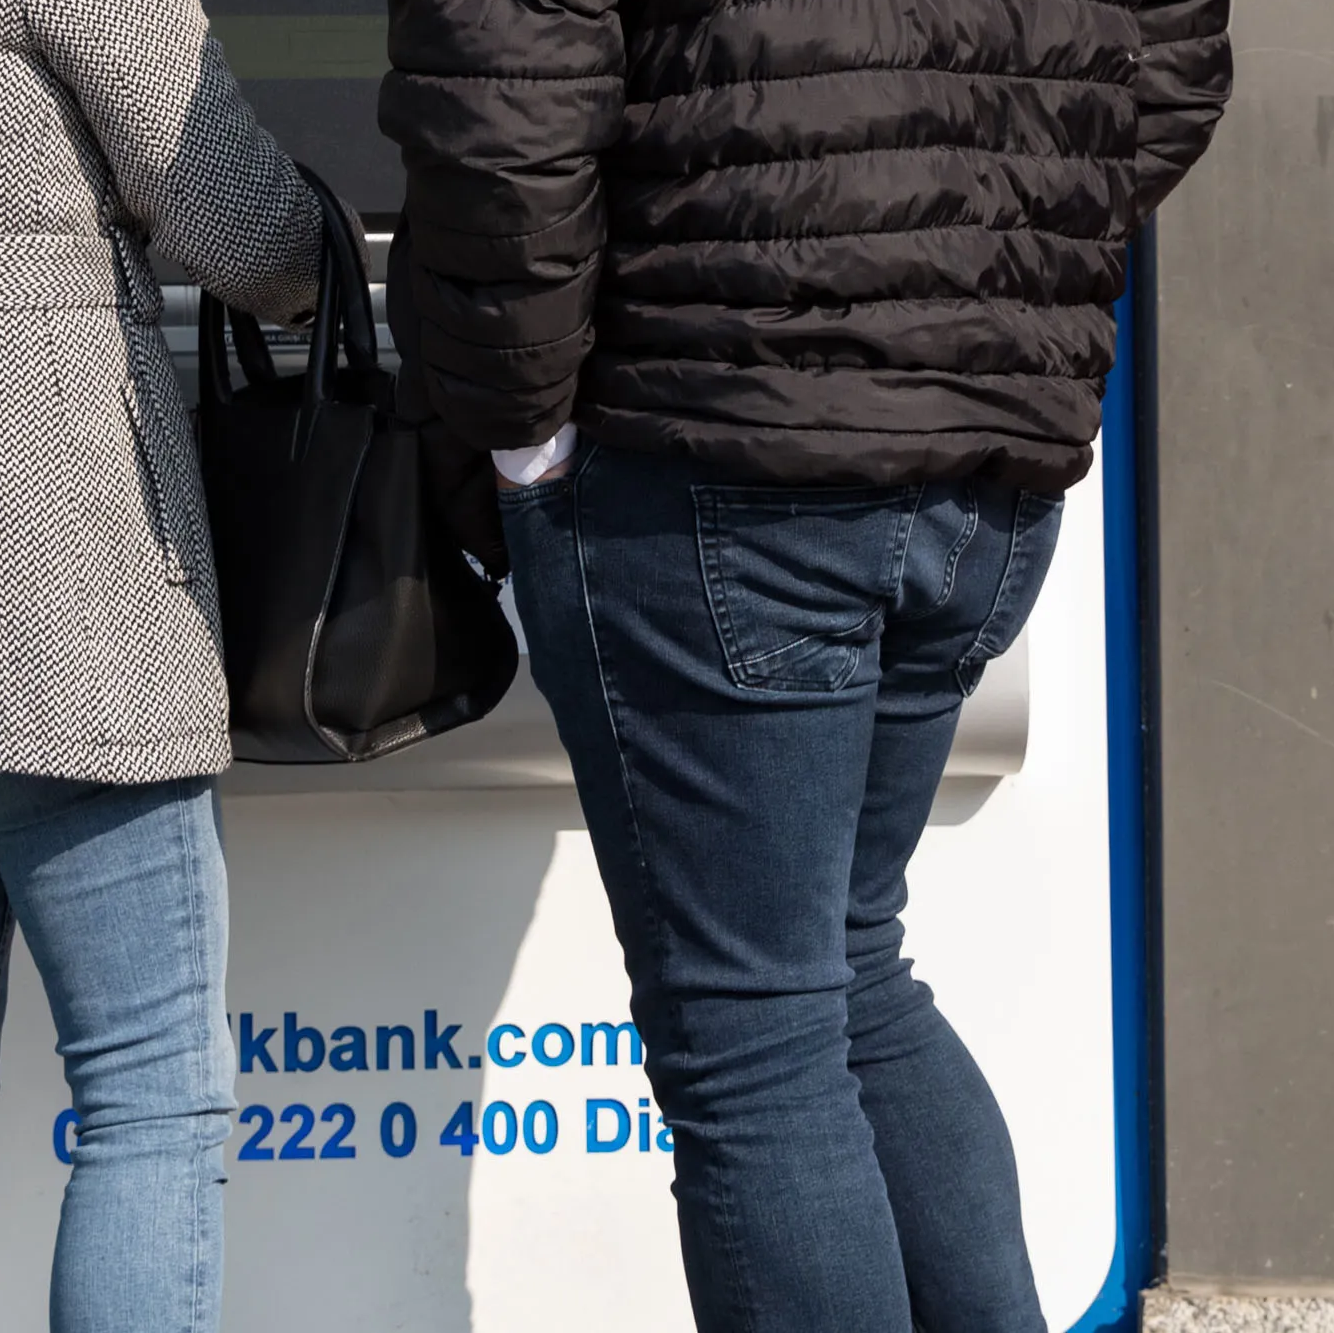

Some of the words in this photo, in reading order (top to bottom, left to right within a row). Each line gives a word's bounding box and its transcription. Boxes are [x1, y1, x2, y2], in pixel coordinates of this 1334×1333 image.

[227, 1009, 644, 1074] kbank.com
[237, 1102, 357, 1161] 222
[379, 1100, 418, 1159] 0
[439, 1099, 559, 1157] 400
